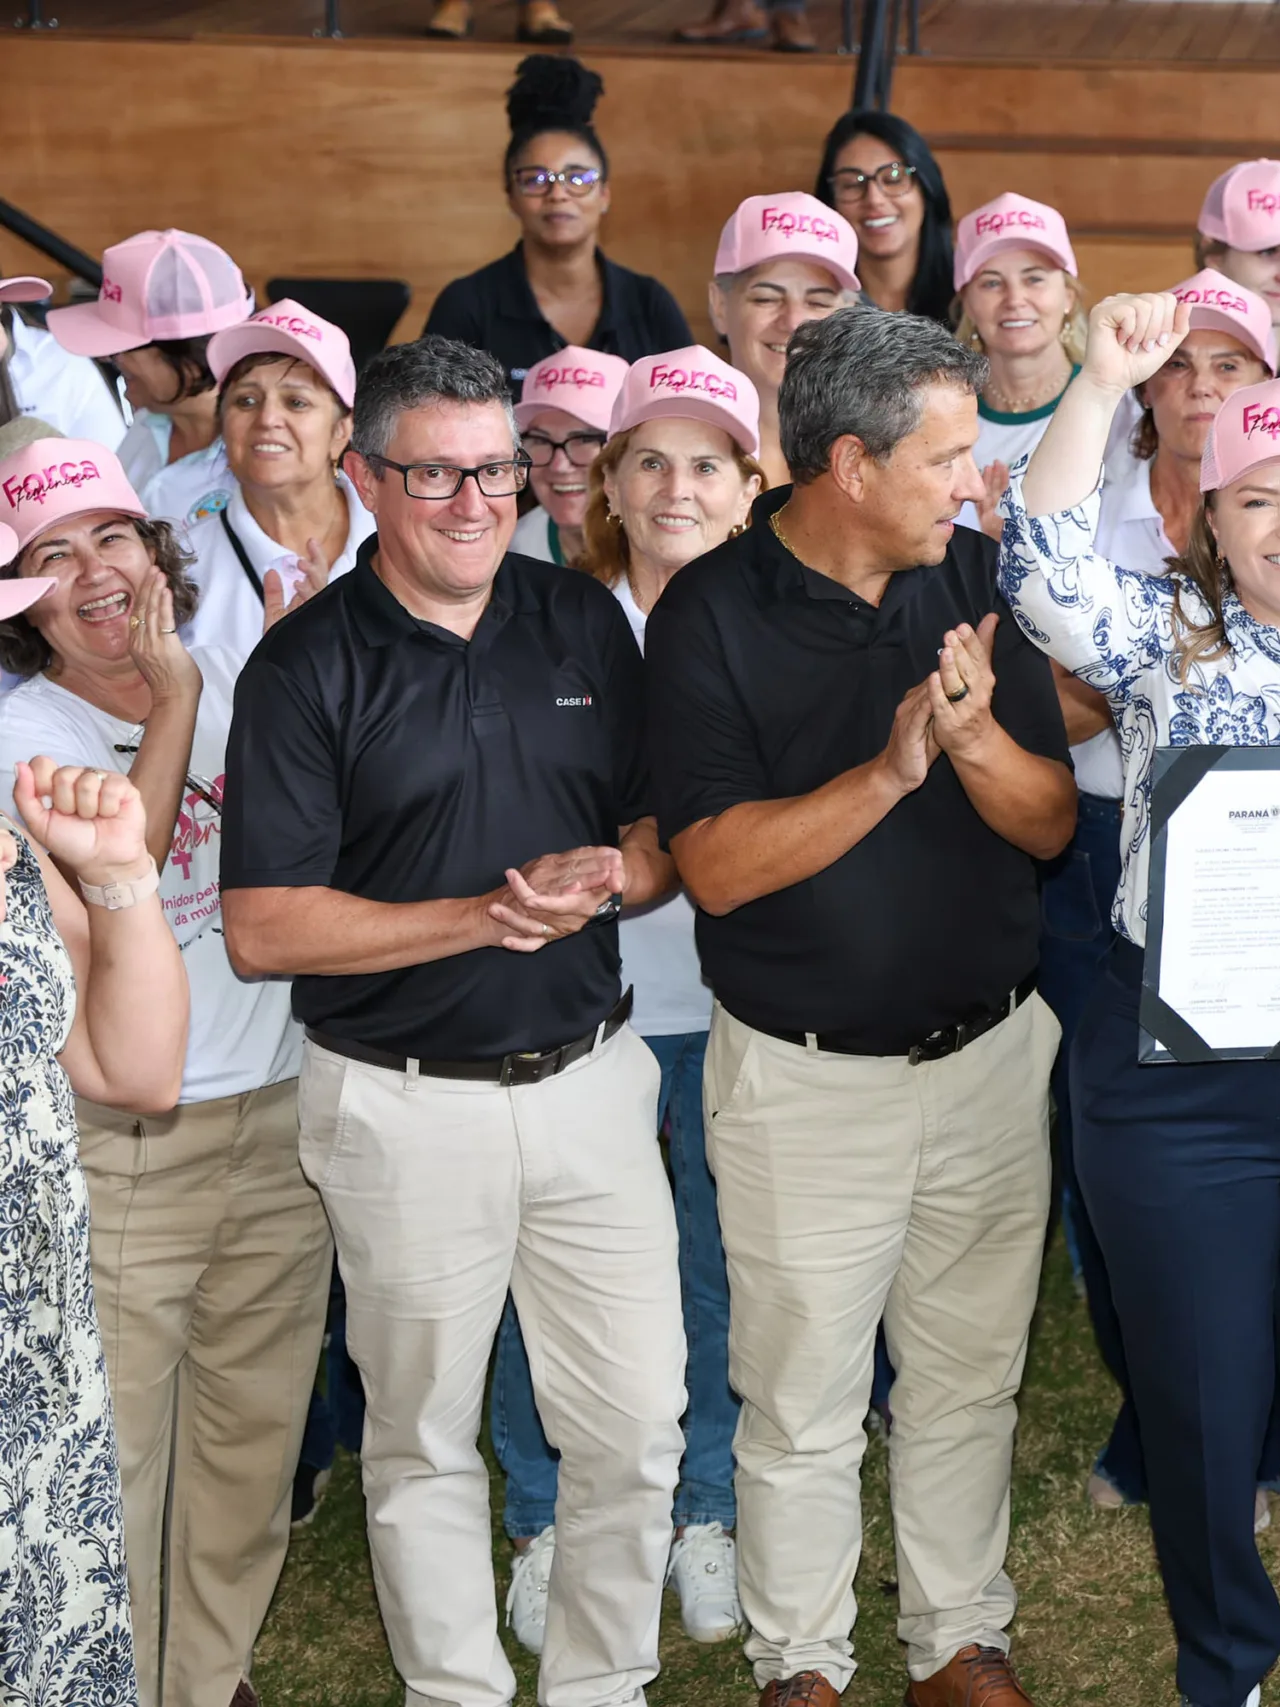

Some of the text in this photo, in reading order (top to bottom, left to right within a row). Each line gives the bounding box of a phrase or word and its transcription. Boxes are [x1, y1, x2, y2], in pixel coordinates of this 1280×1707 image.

[650, 363, 738, 402] Força
[2, 460, 101, 508] Força
[556, 697, 582, 707] CASE
[1228, 808, 1269, 819] PARANÁ
[175, 912, 188, 926] da
